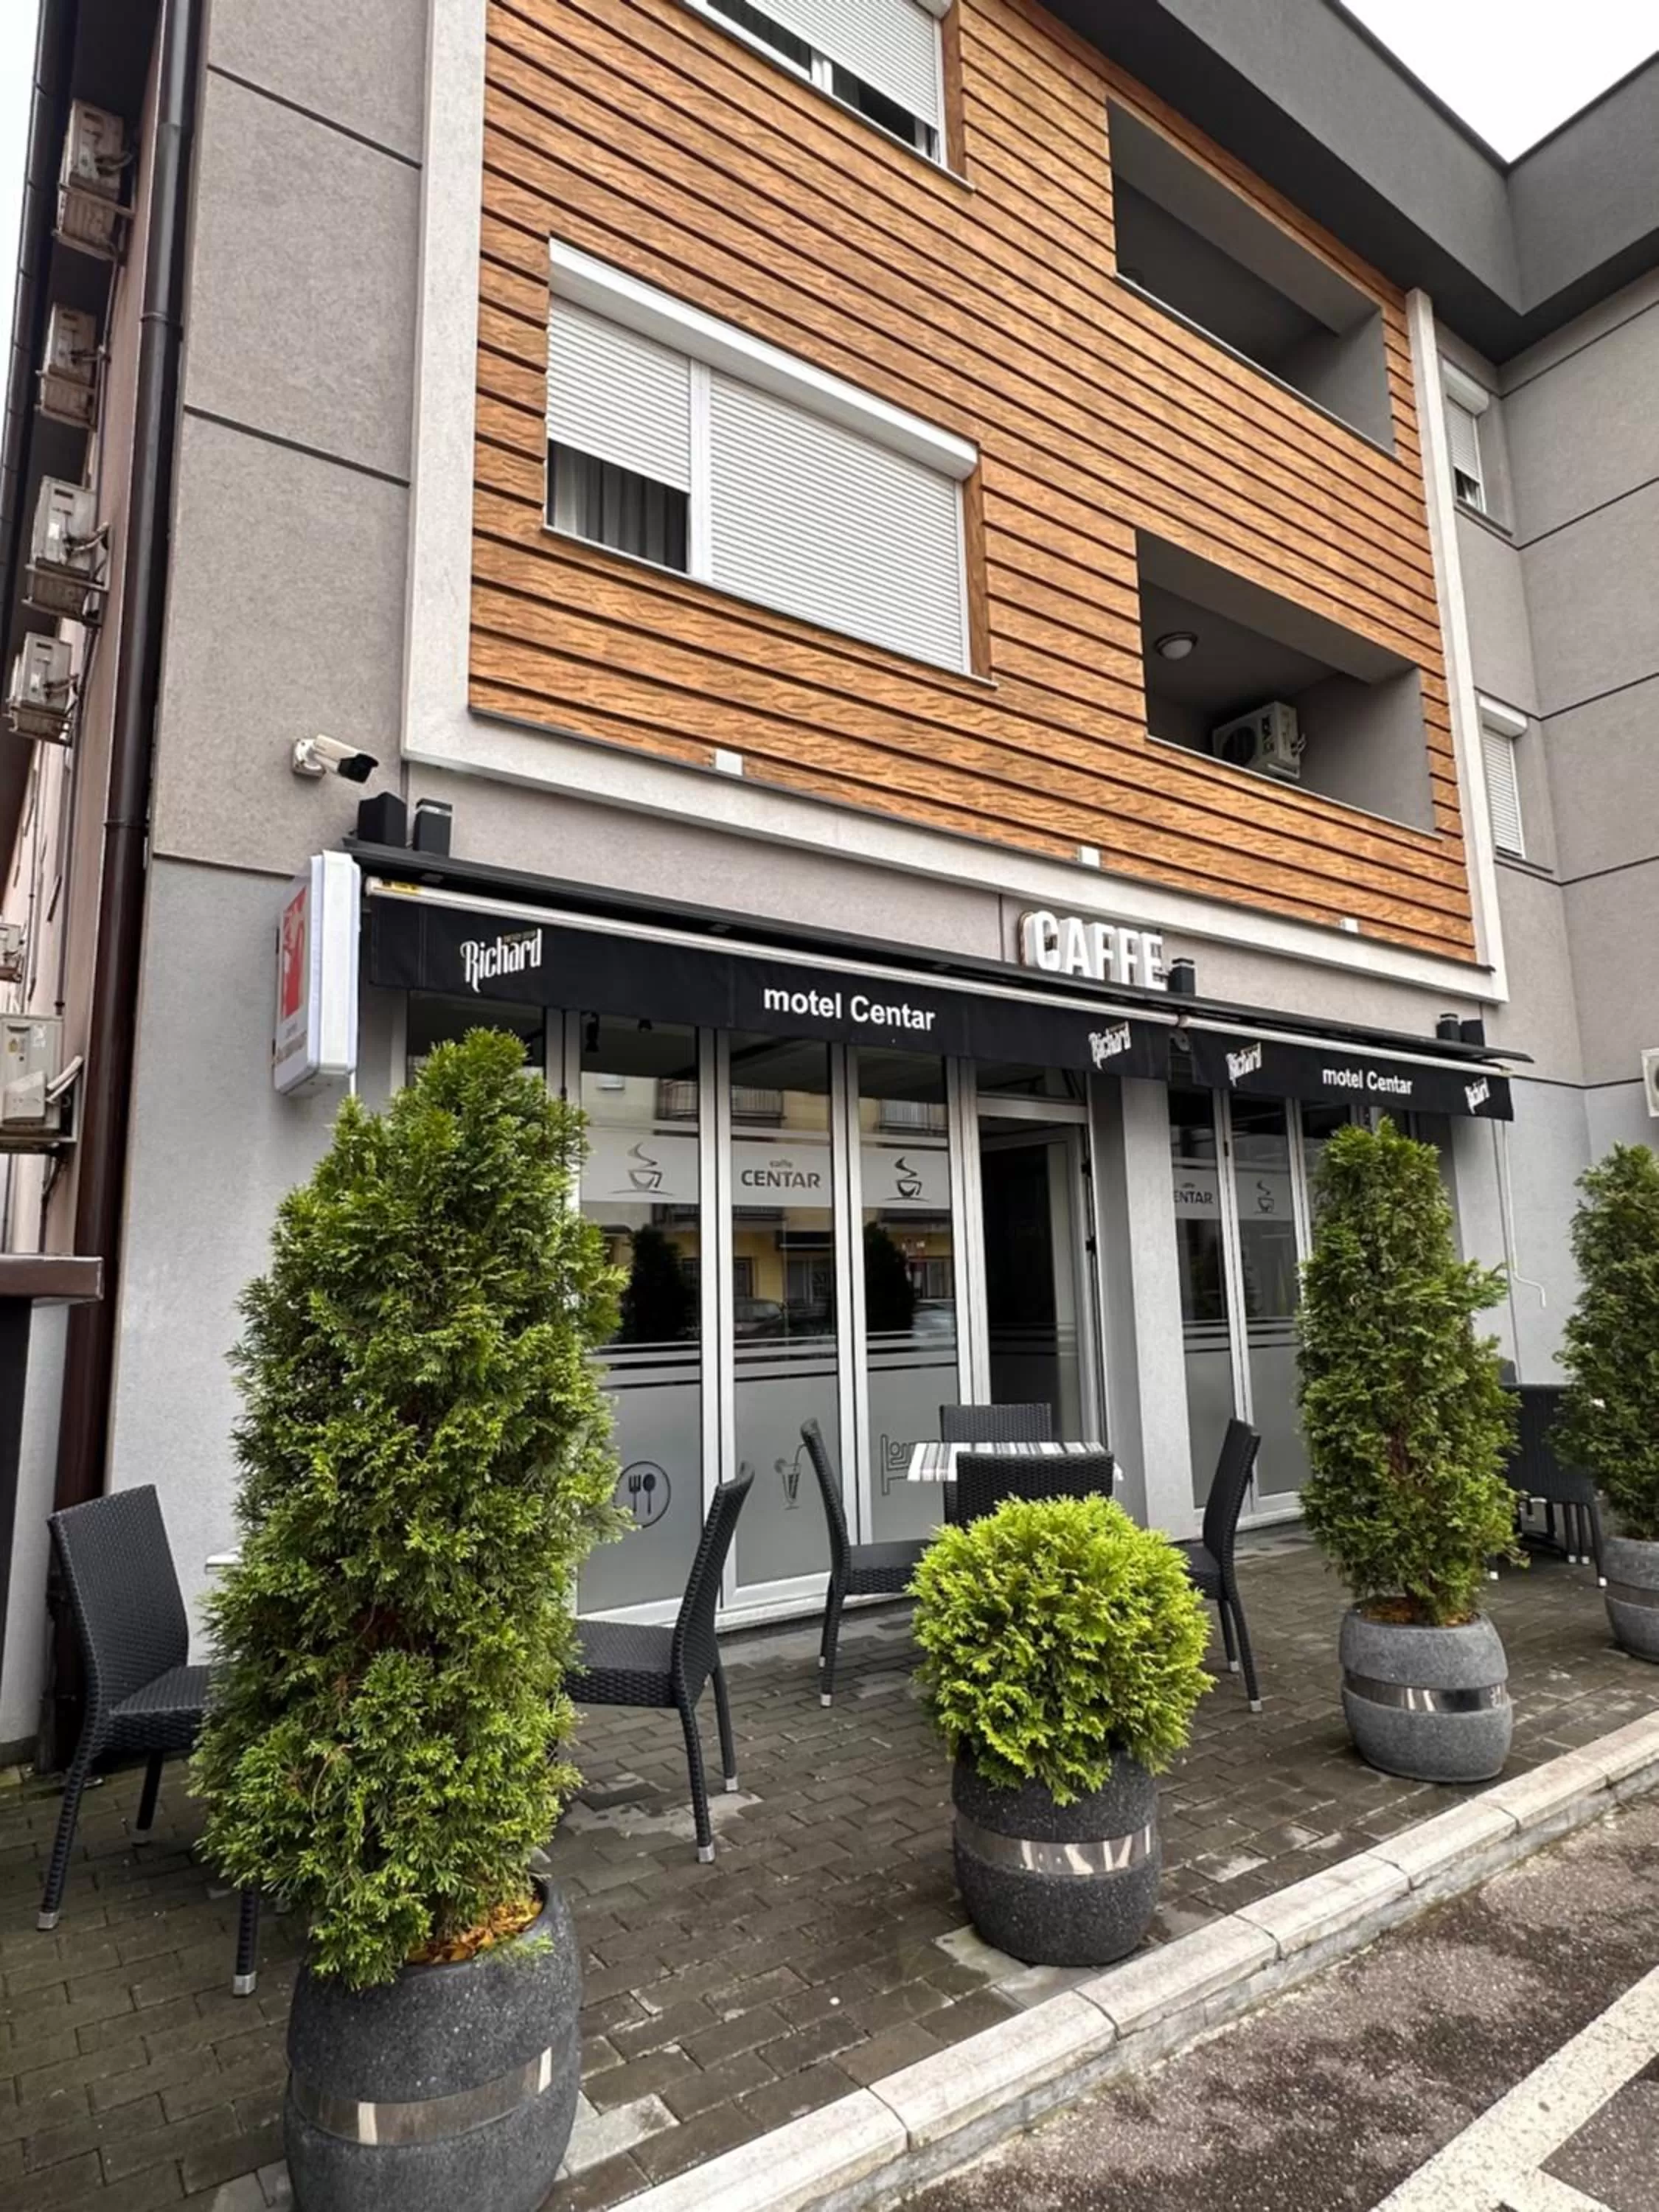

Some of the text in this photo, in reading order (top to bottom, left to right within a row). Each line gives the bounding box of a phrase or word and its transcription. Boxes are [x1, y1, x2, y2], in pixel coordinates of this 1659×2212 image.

[460, 928, 542, 993] Richard
[1023, 910, 1167, 991] CAFFE
[764, 988, 936, 1031] motel Centar
[1322, 1068, 1413, 1095] motel Centar
[740, 1169, 821, 1189] CENTAR
